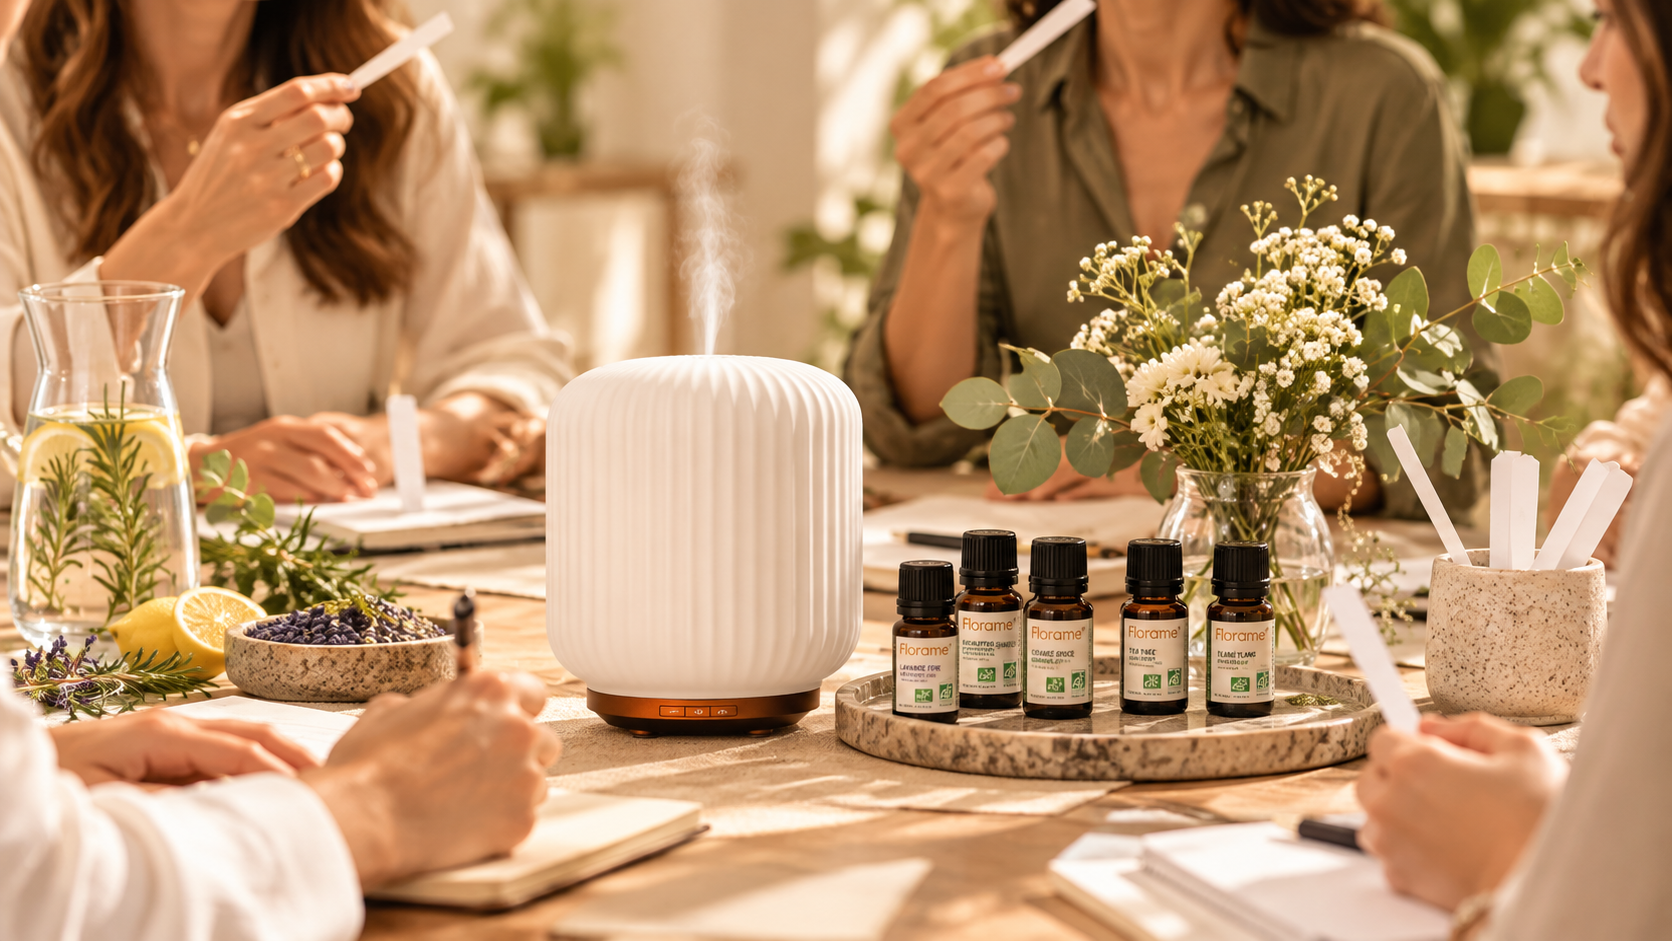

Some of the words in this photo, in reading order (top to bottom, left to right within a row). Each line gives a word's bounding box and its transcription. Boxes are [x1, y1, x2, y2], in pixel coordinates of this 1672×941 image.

[962, 617, 1013, 631] Florame
[1031, 626, 1082, 640] Florame
[1128, 625, 1177, 639] Florame
[1215, 627, 1265, 641] Florame
[899, 643, 949, 656] Florame
